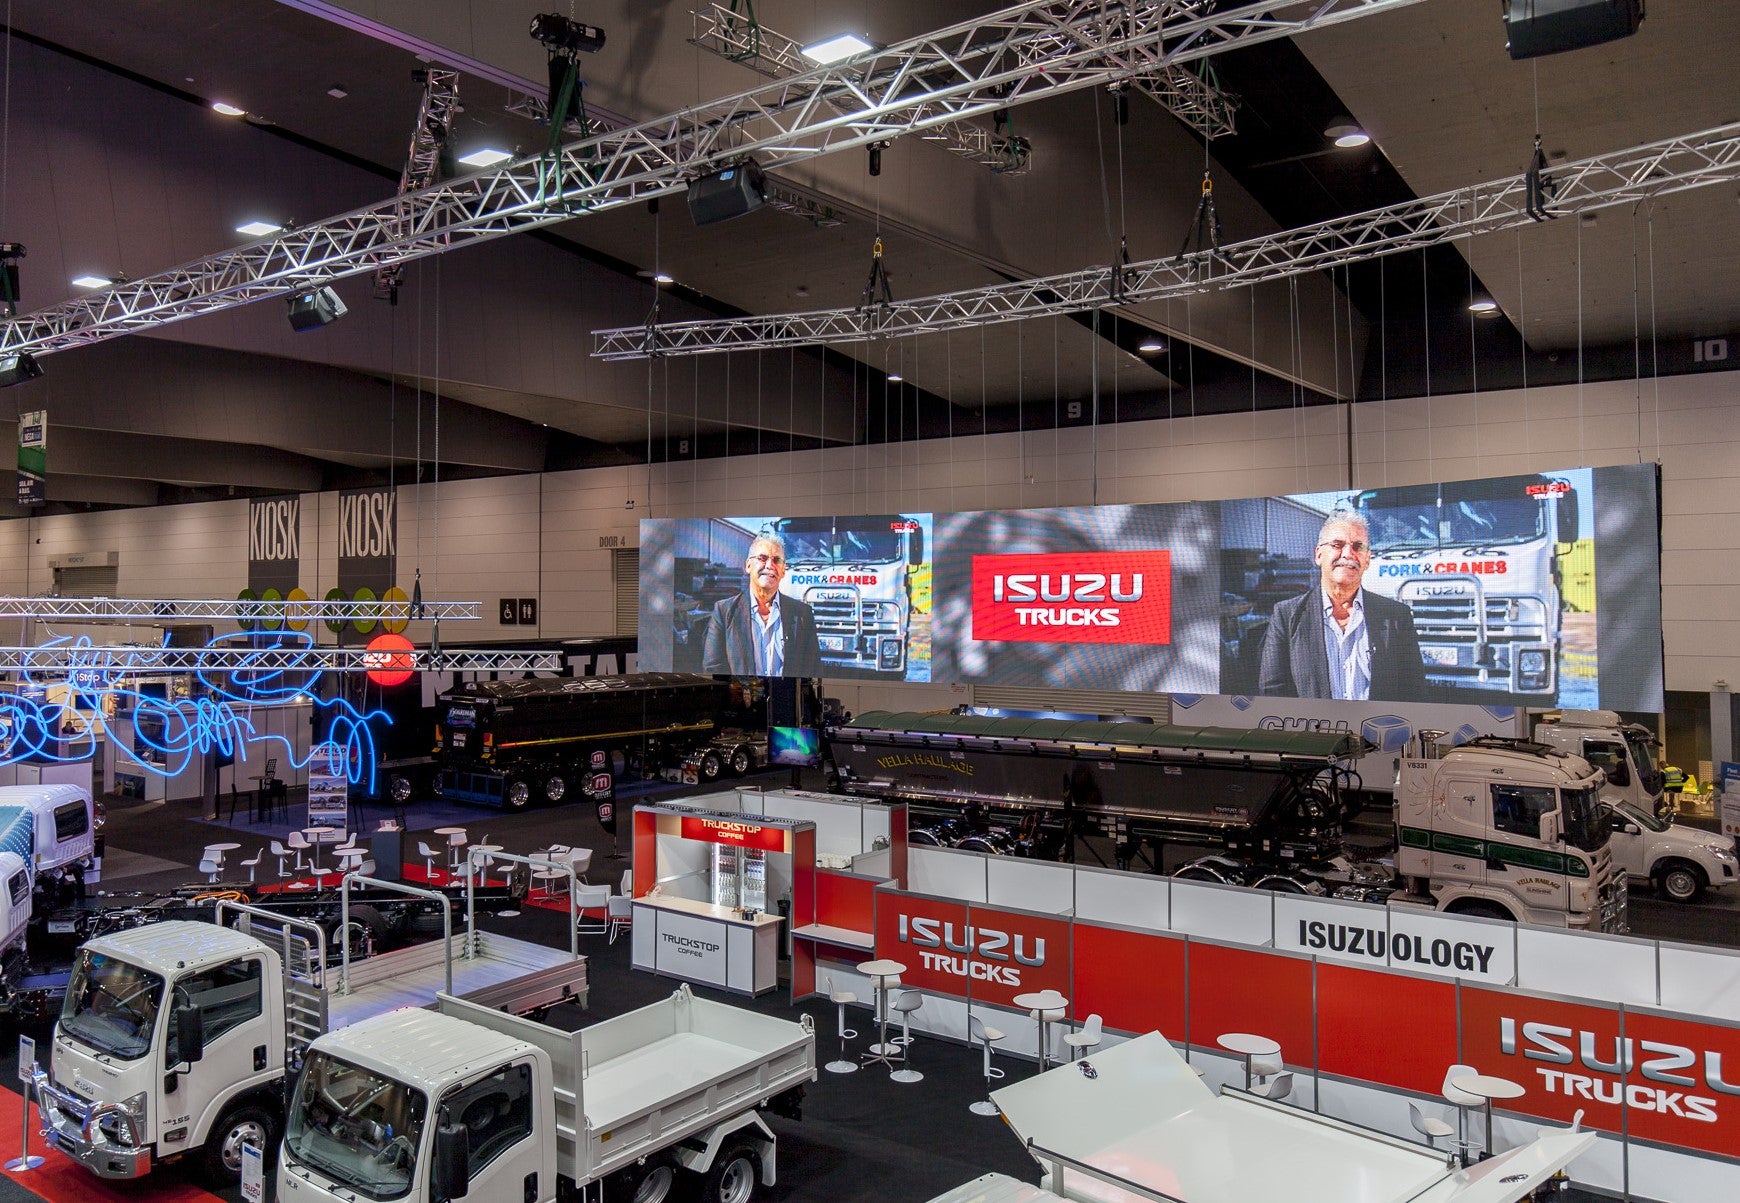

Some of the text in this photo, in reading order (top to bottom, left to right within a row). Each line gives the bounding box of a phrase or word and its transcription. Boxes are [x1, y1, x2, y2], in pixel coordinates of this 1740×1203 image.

[1694, 339, 1728, 362] 10
[1068, 401, 1081, 419] 9
[250, 500, 299, 561] KIOSK
[339, 491, 396, 558] KIOSK
[600, 535, 626, 548] DOOR 4
[993, 573, 1144, 603] ISUZU
[1416, 585, 1465, 596] ISUZU
[1014, 608, 1121, 627] TRUCKS
[914, 752, 974, 776] HAULAGE
[701, 818, 761, 834] TRUCKSTOP
[718, 831, 744, 840] COFFEE
[662, 933, 720, 952] TRUCKSTOP
[899, 914, 1045, 967] ISUZU
[1299, 919, 1495, 974] ISUZUOLOGY
[678, 947, 703, 958] COFFEE
[919, 951, 1021, 987] TRUCKS
[1536, 1067, 1718, 1123] TRUCKS
